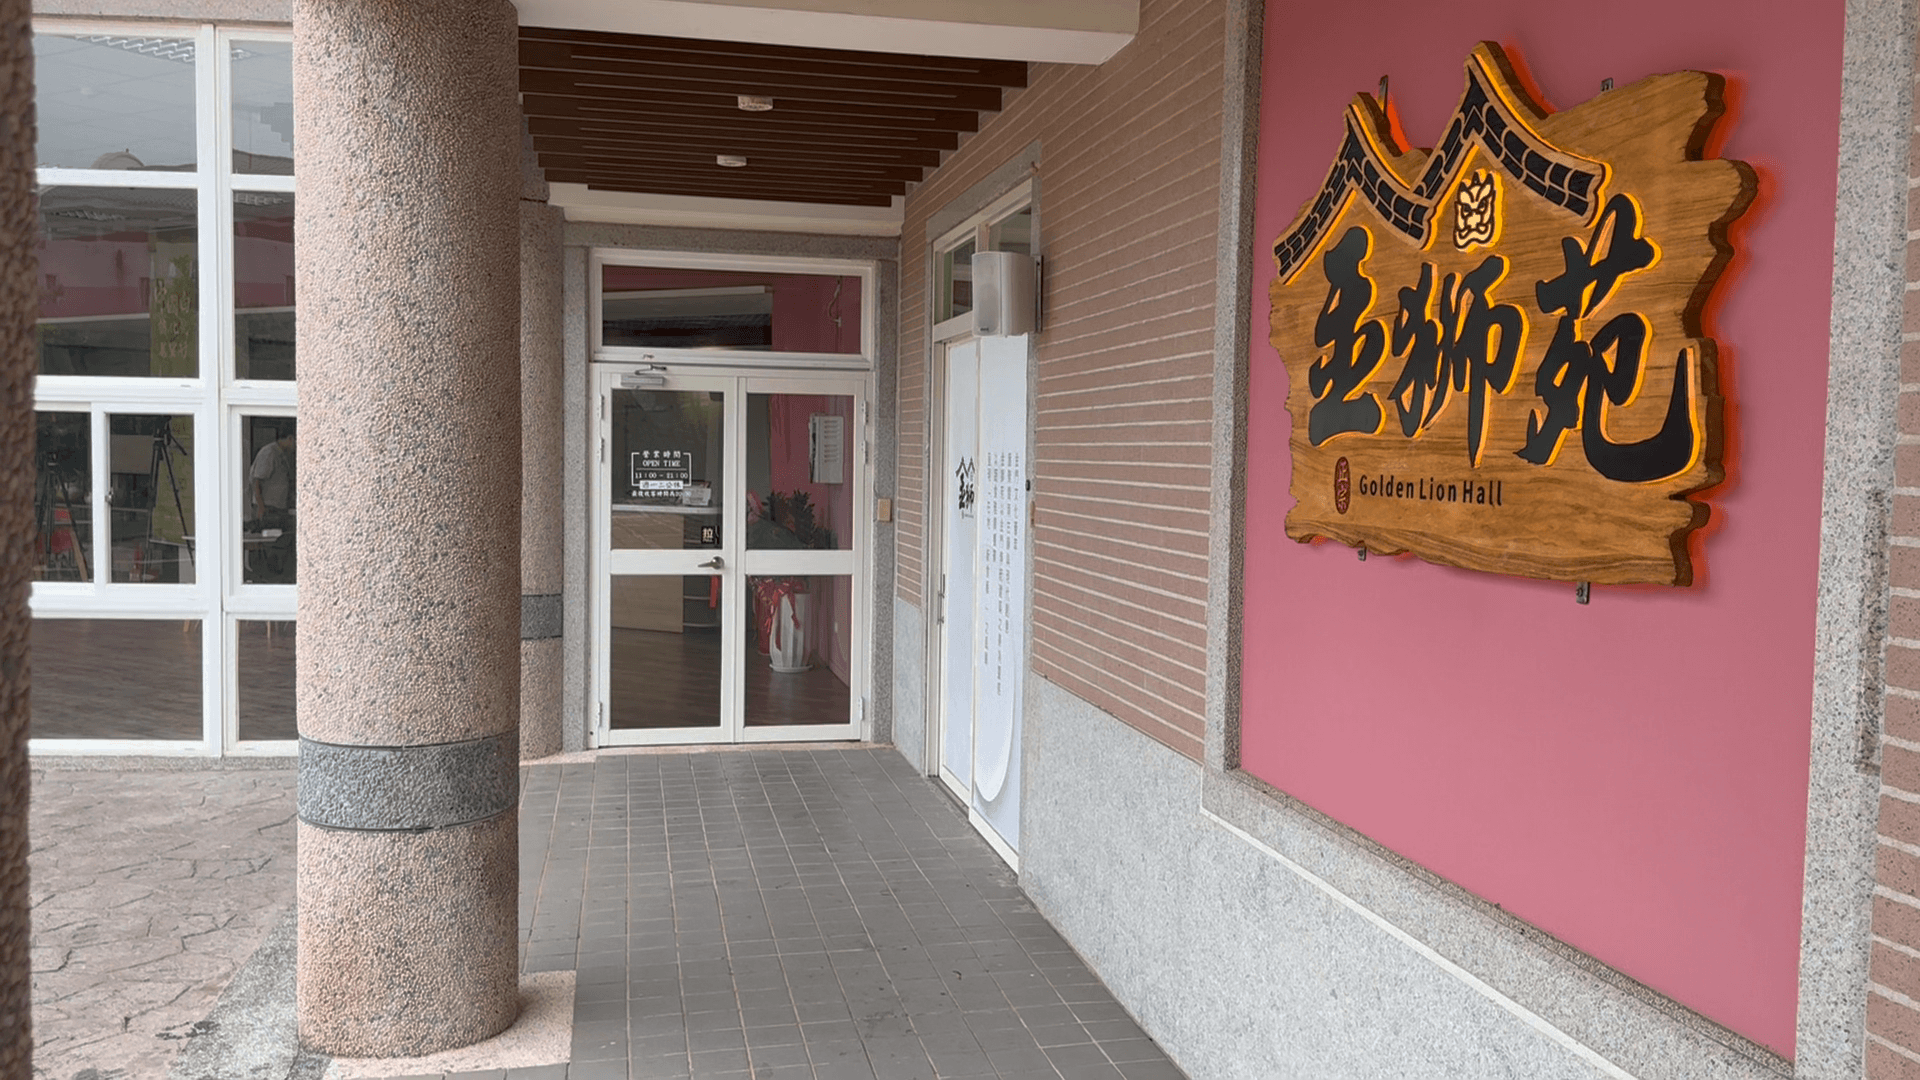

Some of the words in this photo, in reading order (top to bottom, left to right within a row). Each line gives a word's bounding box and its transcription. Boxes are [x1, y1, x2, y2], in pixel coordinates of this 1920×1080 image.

[1359, 474, 1415, 499] Golden
[1419, 477, 1457, 502] Lion
[1463, 480, 1502, 506] Hall
